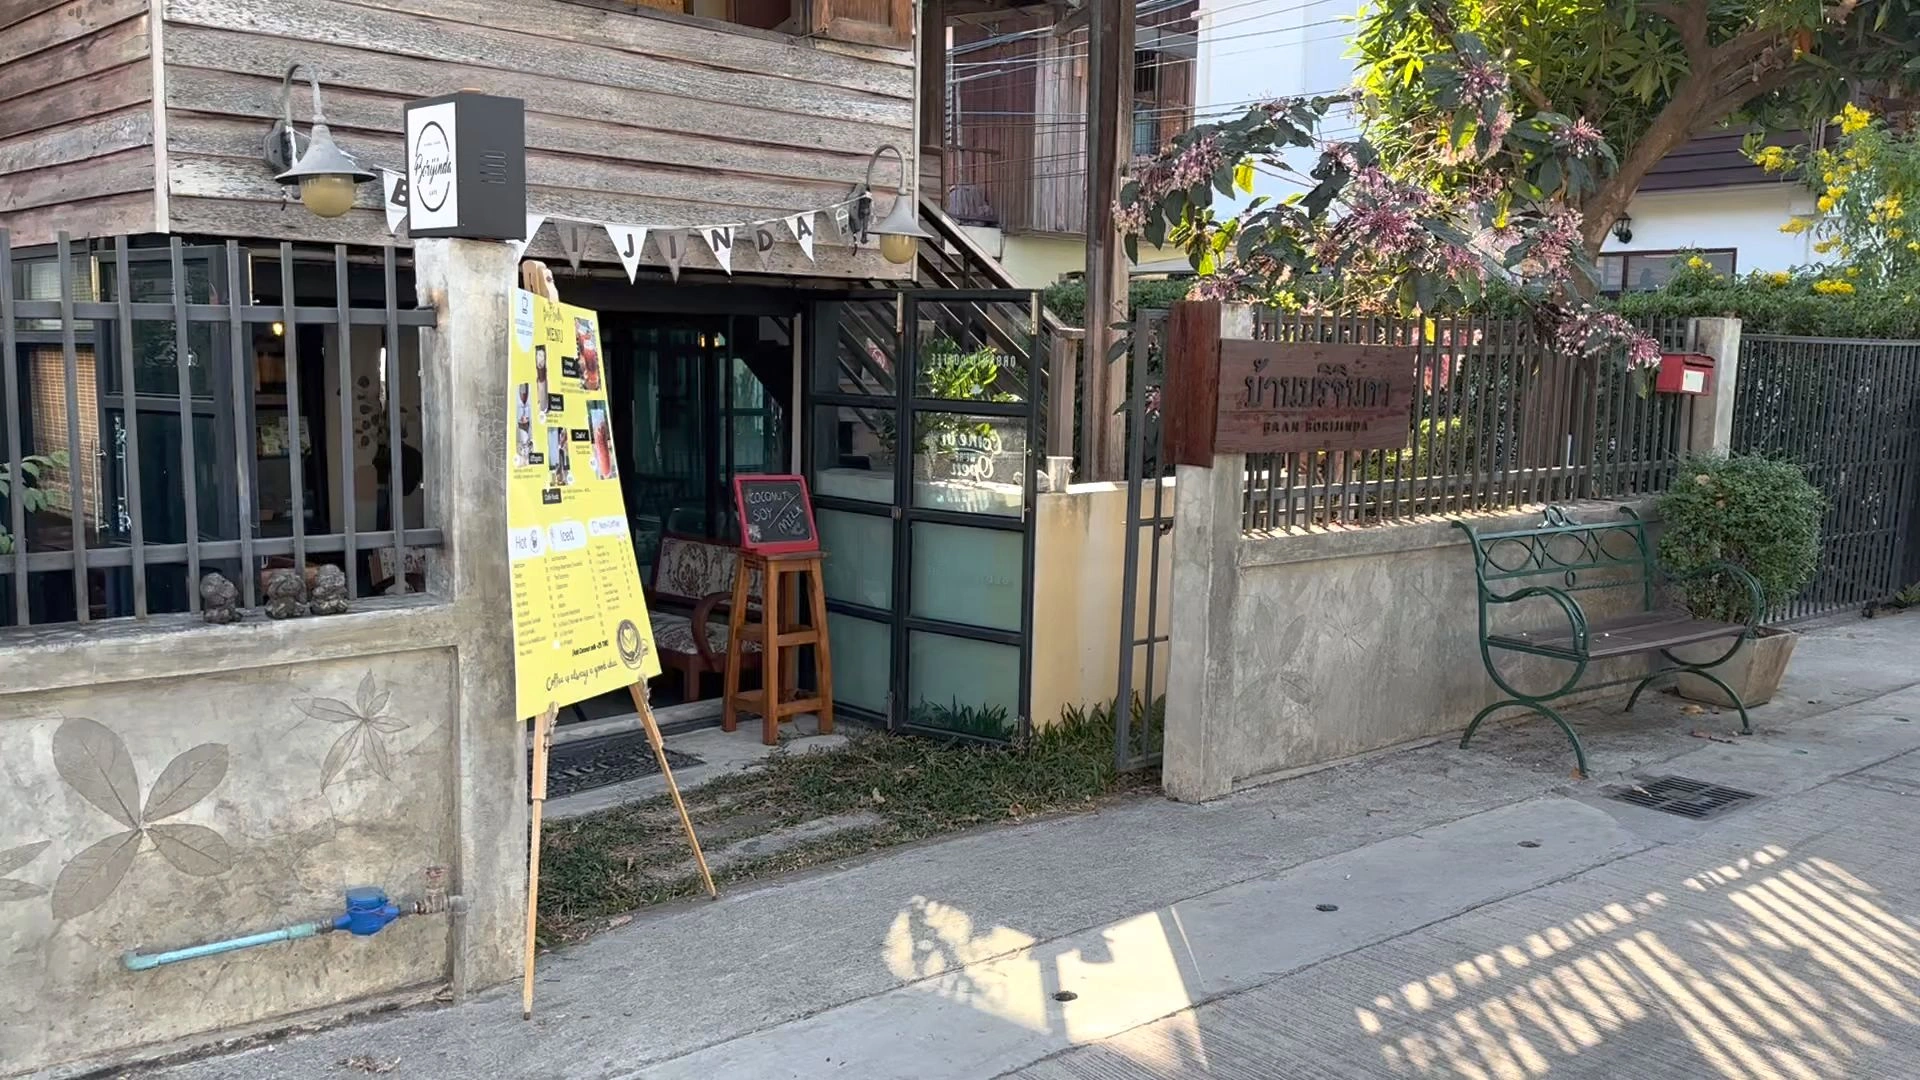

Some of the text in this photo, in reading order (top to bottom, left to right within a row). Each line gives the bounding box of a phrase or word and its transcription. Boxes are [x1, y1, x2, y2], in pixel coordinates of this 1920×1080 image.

[1263, 420, 1369, 435] BAAN BORIJINDA
[749, 491, 788, 504] COCONUT
[752, 507, 773, 522] SOY
[778, 506, 804, 534] MILK
[515, 535, 528, 549] Hot
[560, 528, 575, 542] Iced
